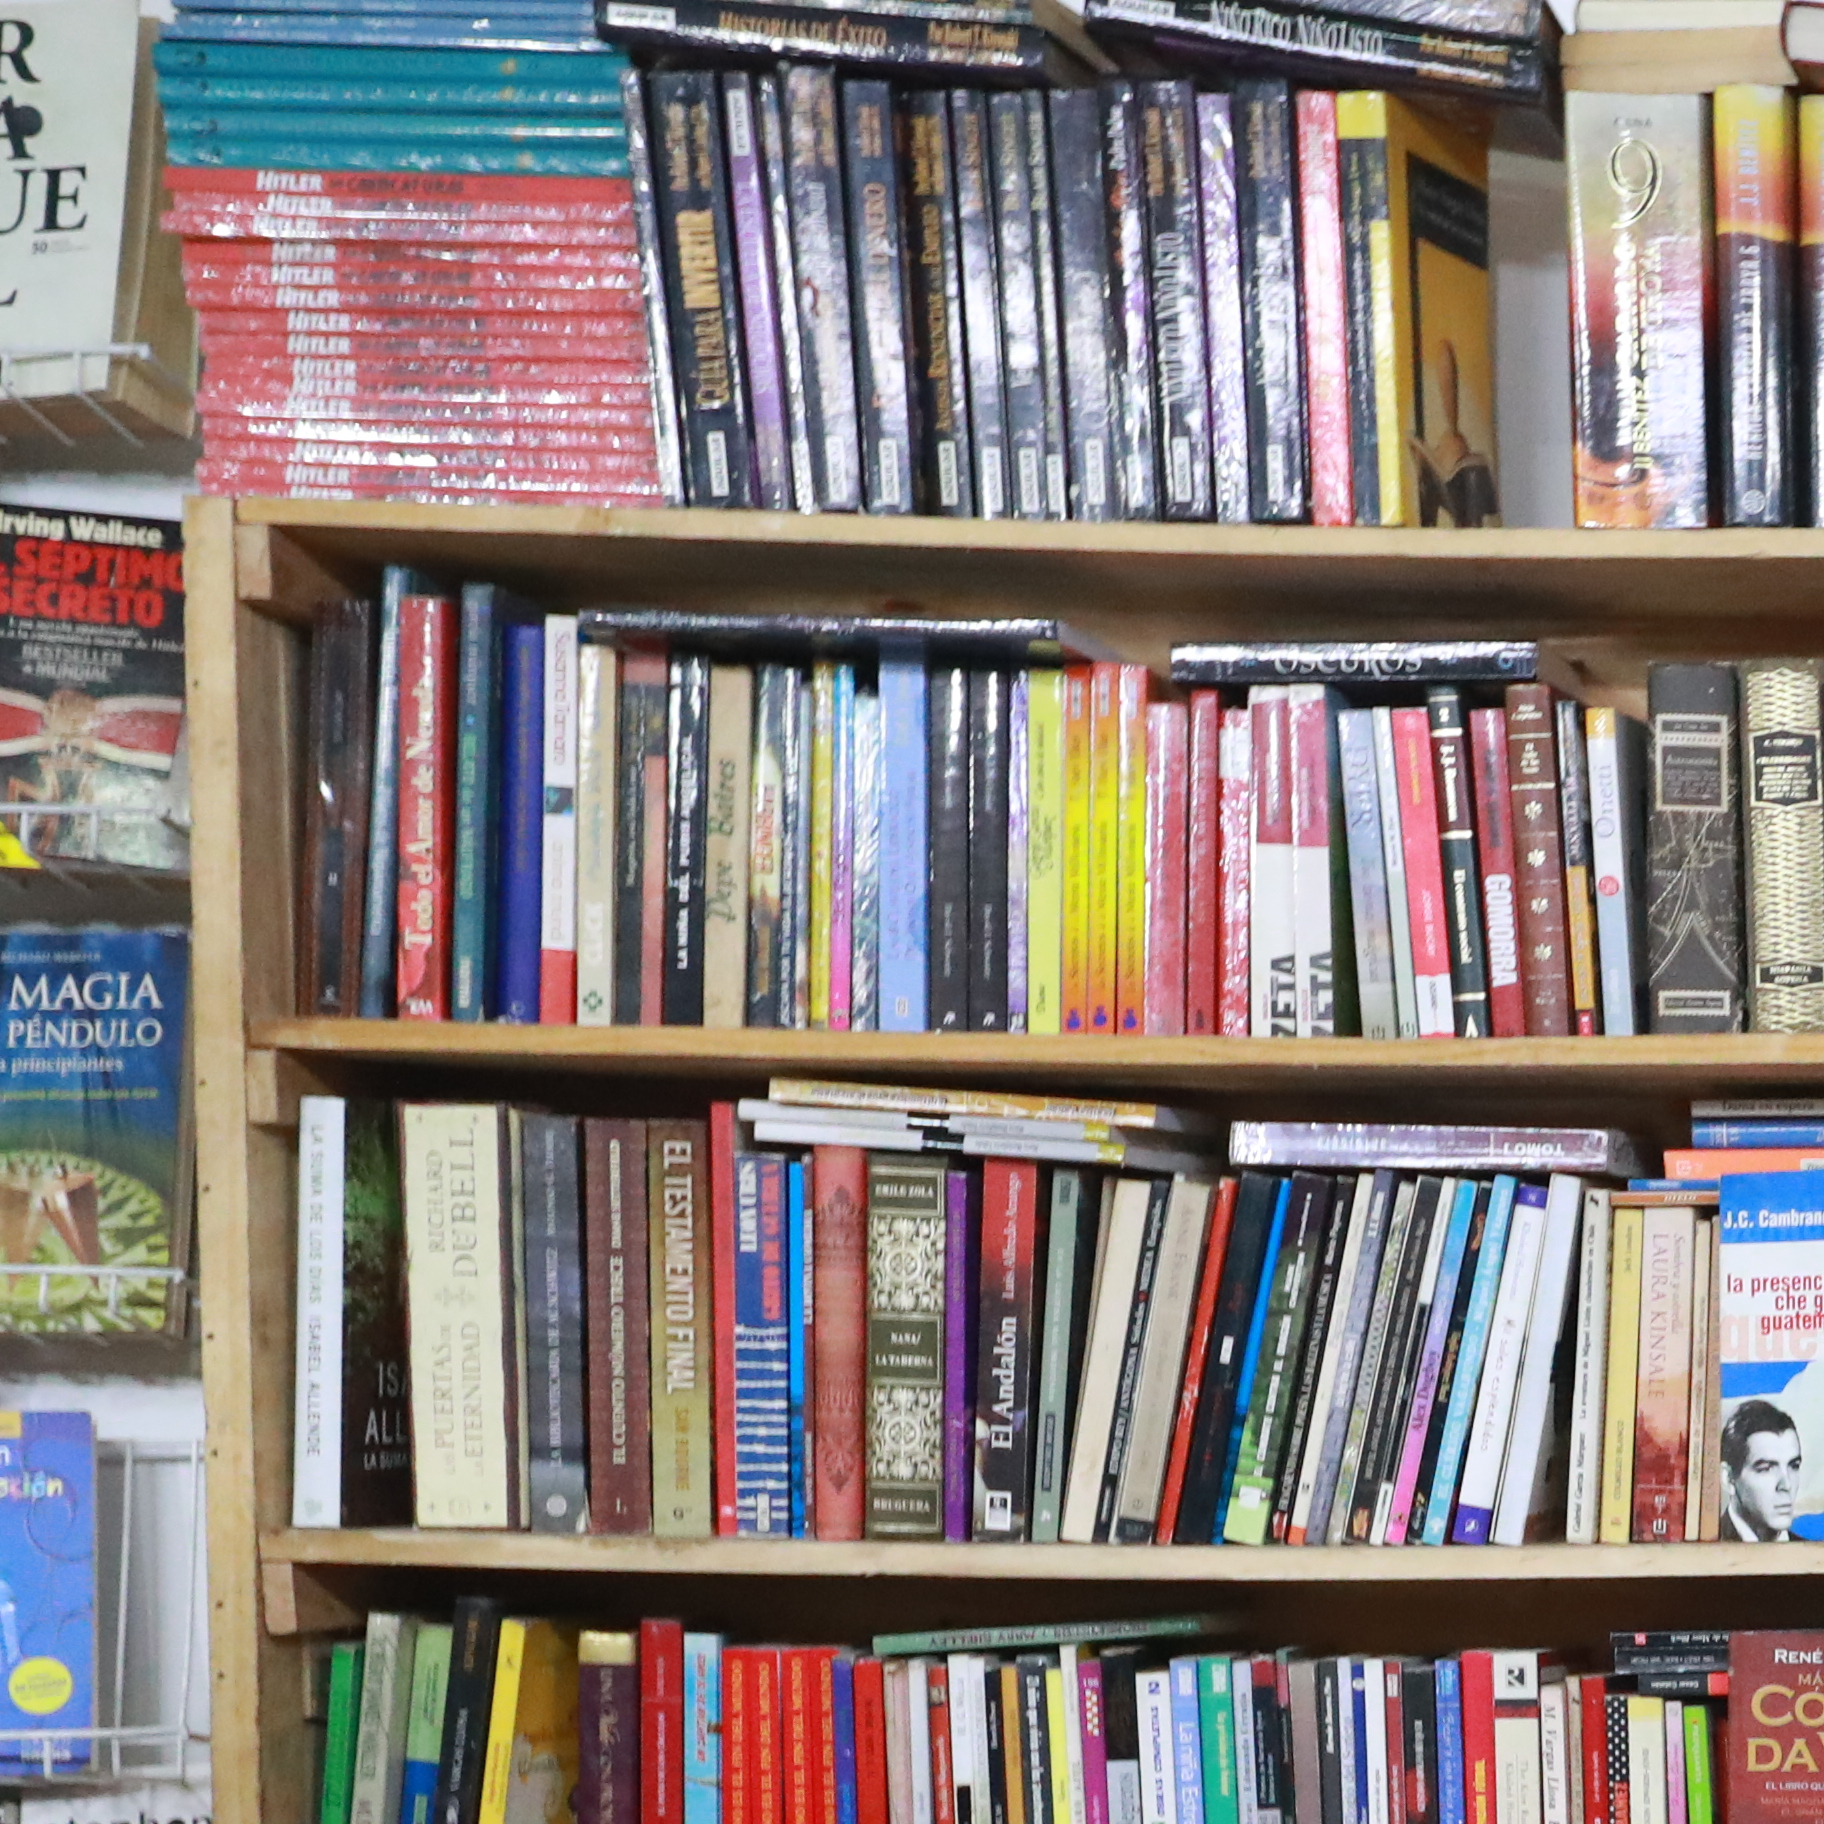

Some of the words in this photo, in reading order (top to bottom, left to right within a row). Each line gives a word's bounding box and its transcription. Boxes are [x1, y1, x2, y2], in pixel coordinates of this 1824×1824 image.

[69, 514, 163, 548] Wallace
[1484, 873, 1518, 987] GOMORRA
[8, 970, 163, 1011] MAGIA
[663, 1140, 692, 1169] EL
[664, 1174, 694, 1320] TESTAMENTO
[1727, 1274, 1743, 1293] la
[1775, 1291, 1807, 1310] che
[666, 1326, 696, 1394] FINAL
[992, 1316, 1017, 1420] Andalón
[992, 1424, 1014, 1450] El
[1774, 1648, 1823, 1665] RENÉ
